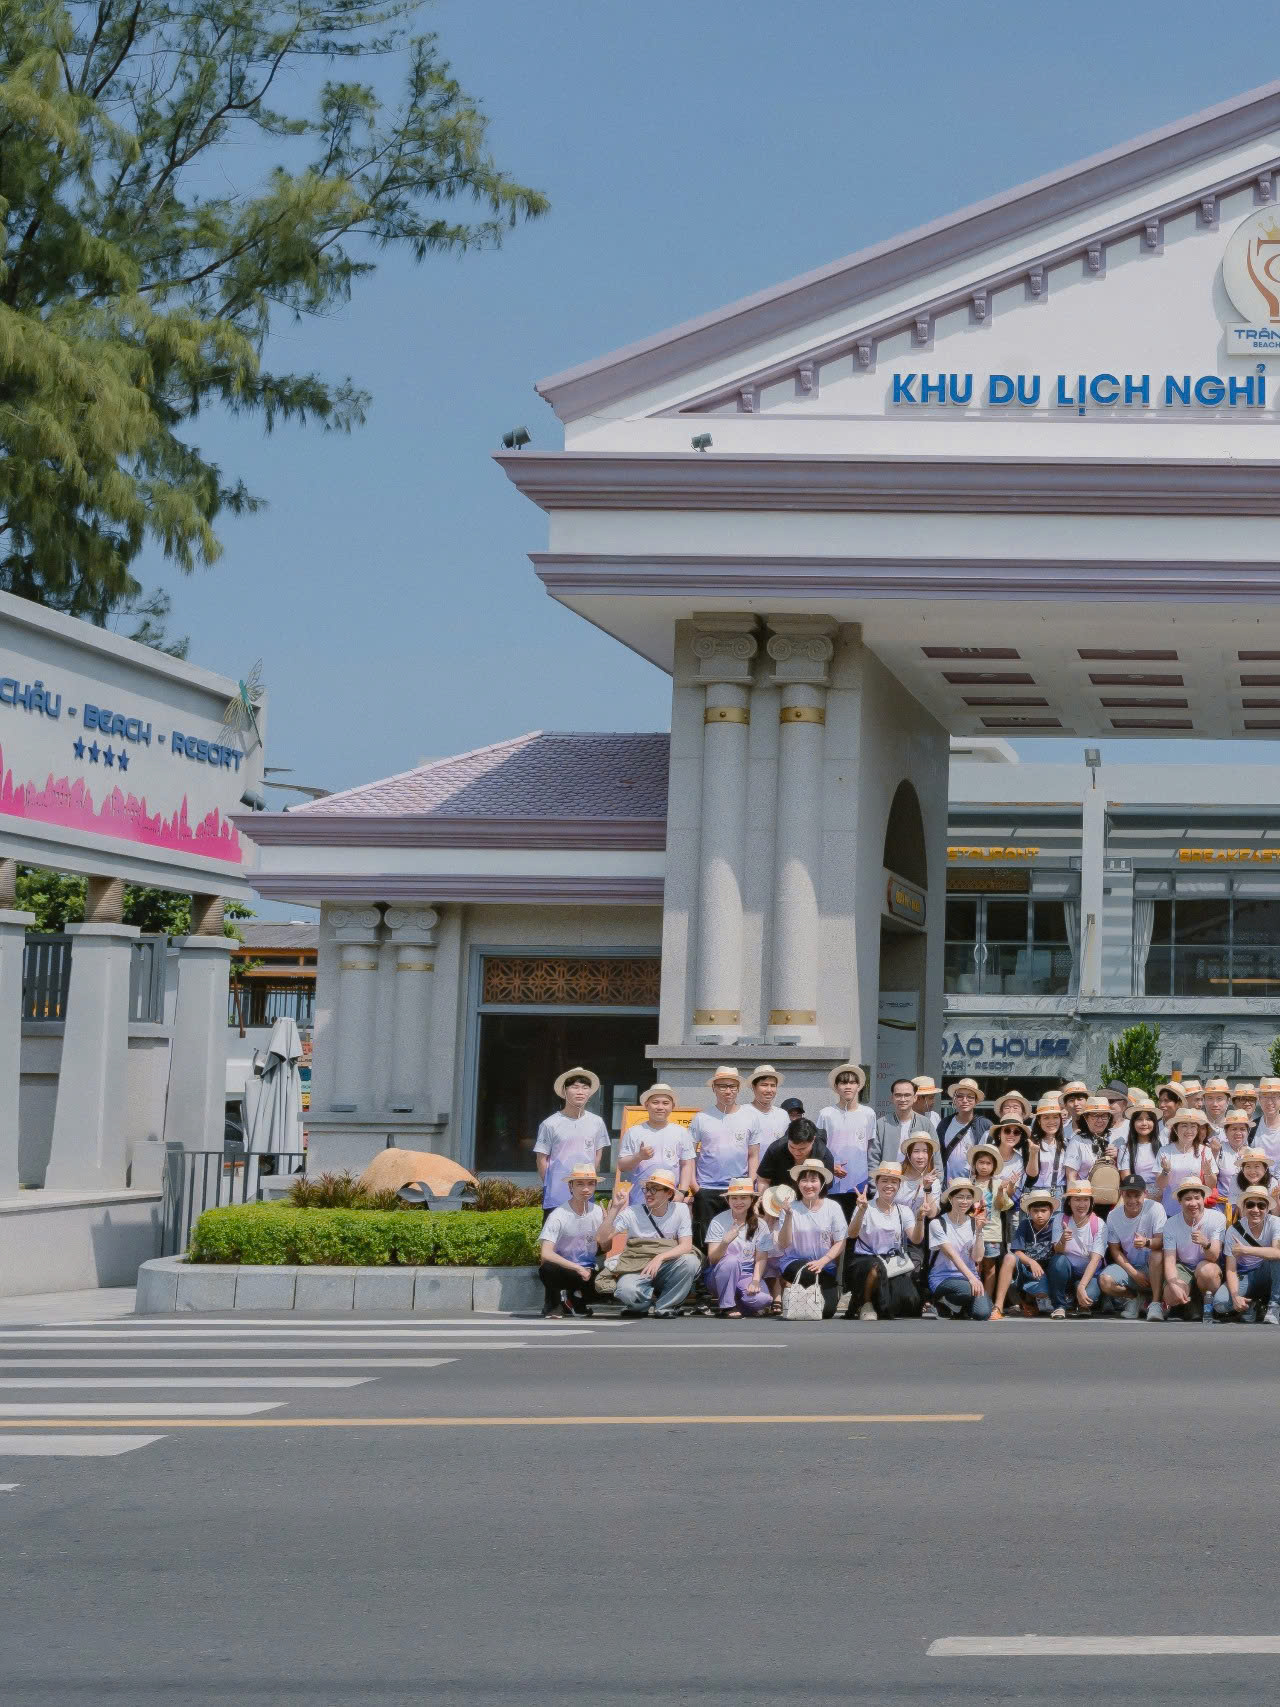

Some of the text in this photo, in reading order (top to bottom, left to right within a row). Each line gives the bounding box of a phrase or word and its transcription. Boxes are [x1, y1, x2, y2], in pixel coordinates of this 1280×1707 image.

[892, 373, 973, 405] KHU
[988, 374, 1041, 406] DU
[1057, 373, 1150, 416] LỊCH
[1165, 363, 1266, 407] NGHỈ
[0, 677, 61, 717] CHÂU
[83, 703, 152, 744] BEACH
[172, 730, 243, 770] RESORT
[946, 846, 1041, 861] STAURANT
[992, 1037, 1070, 1057] HOUSE
[975, 1061, 1015, 1070] RESORT
